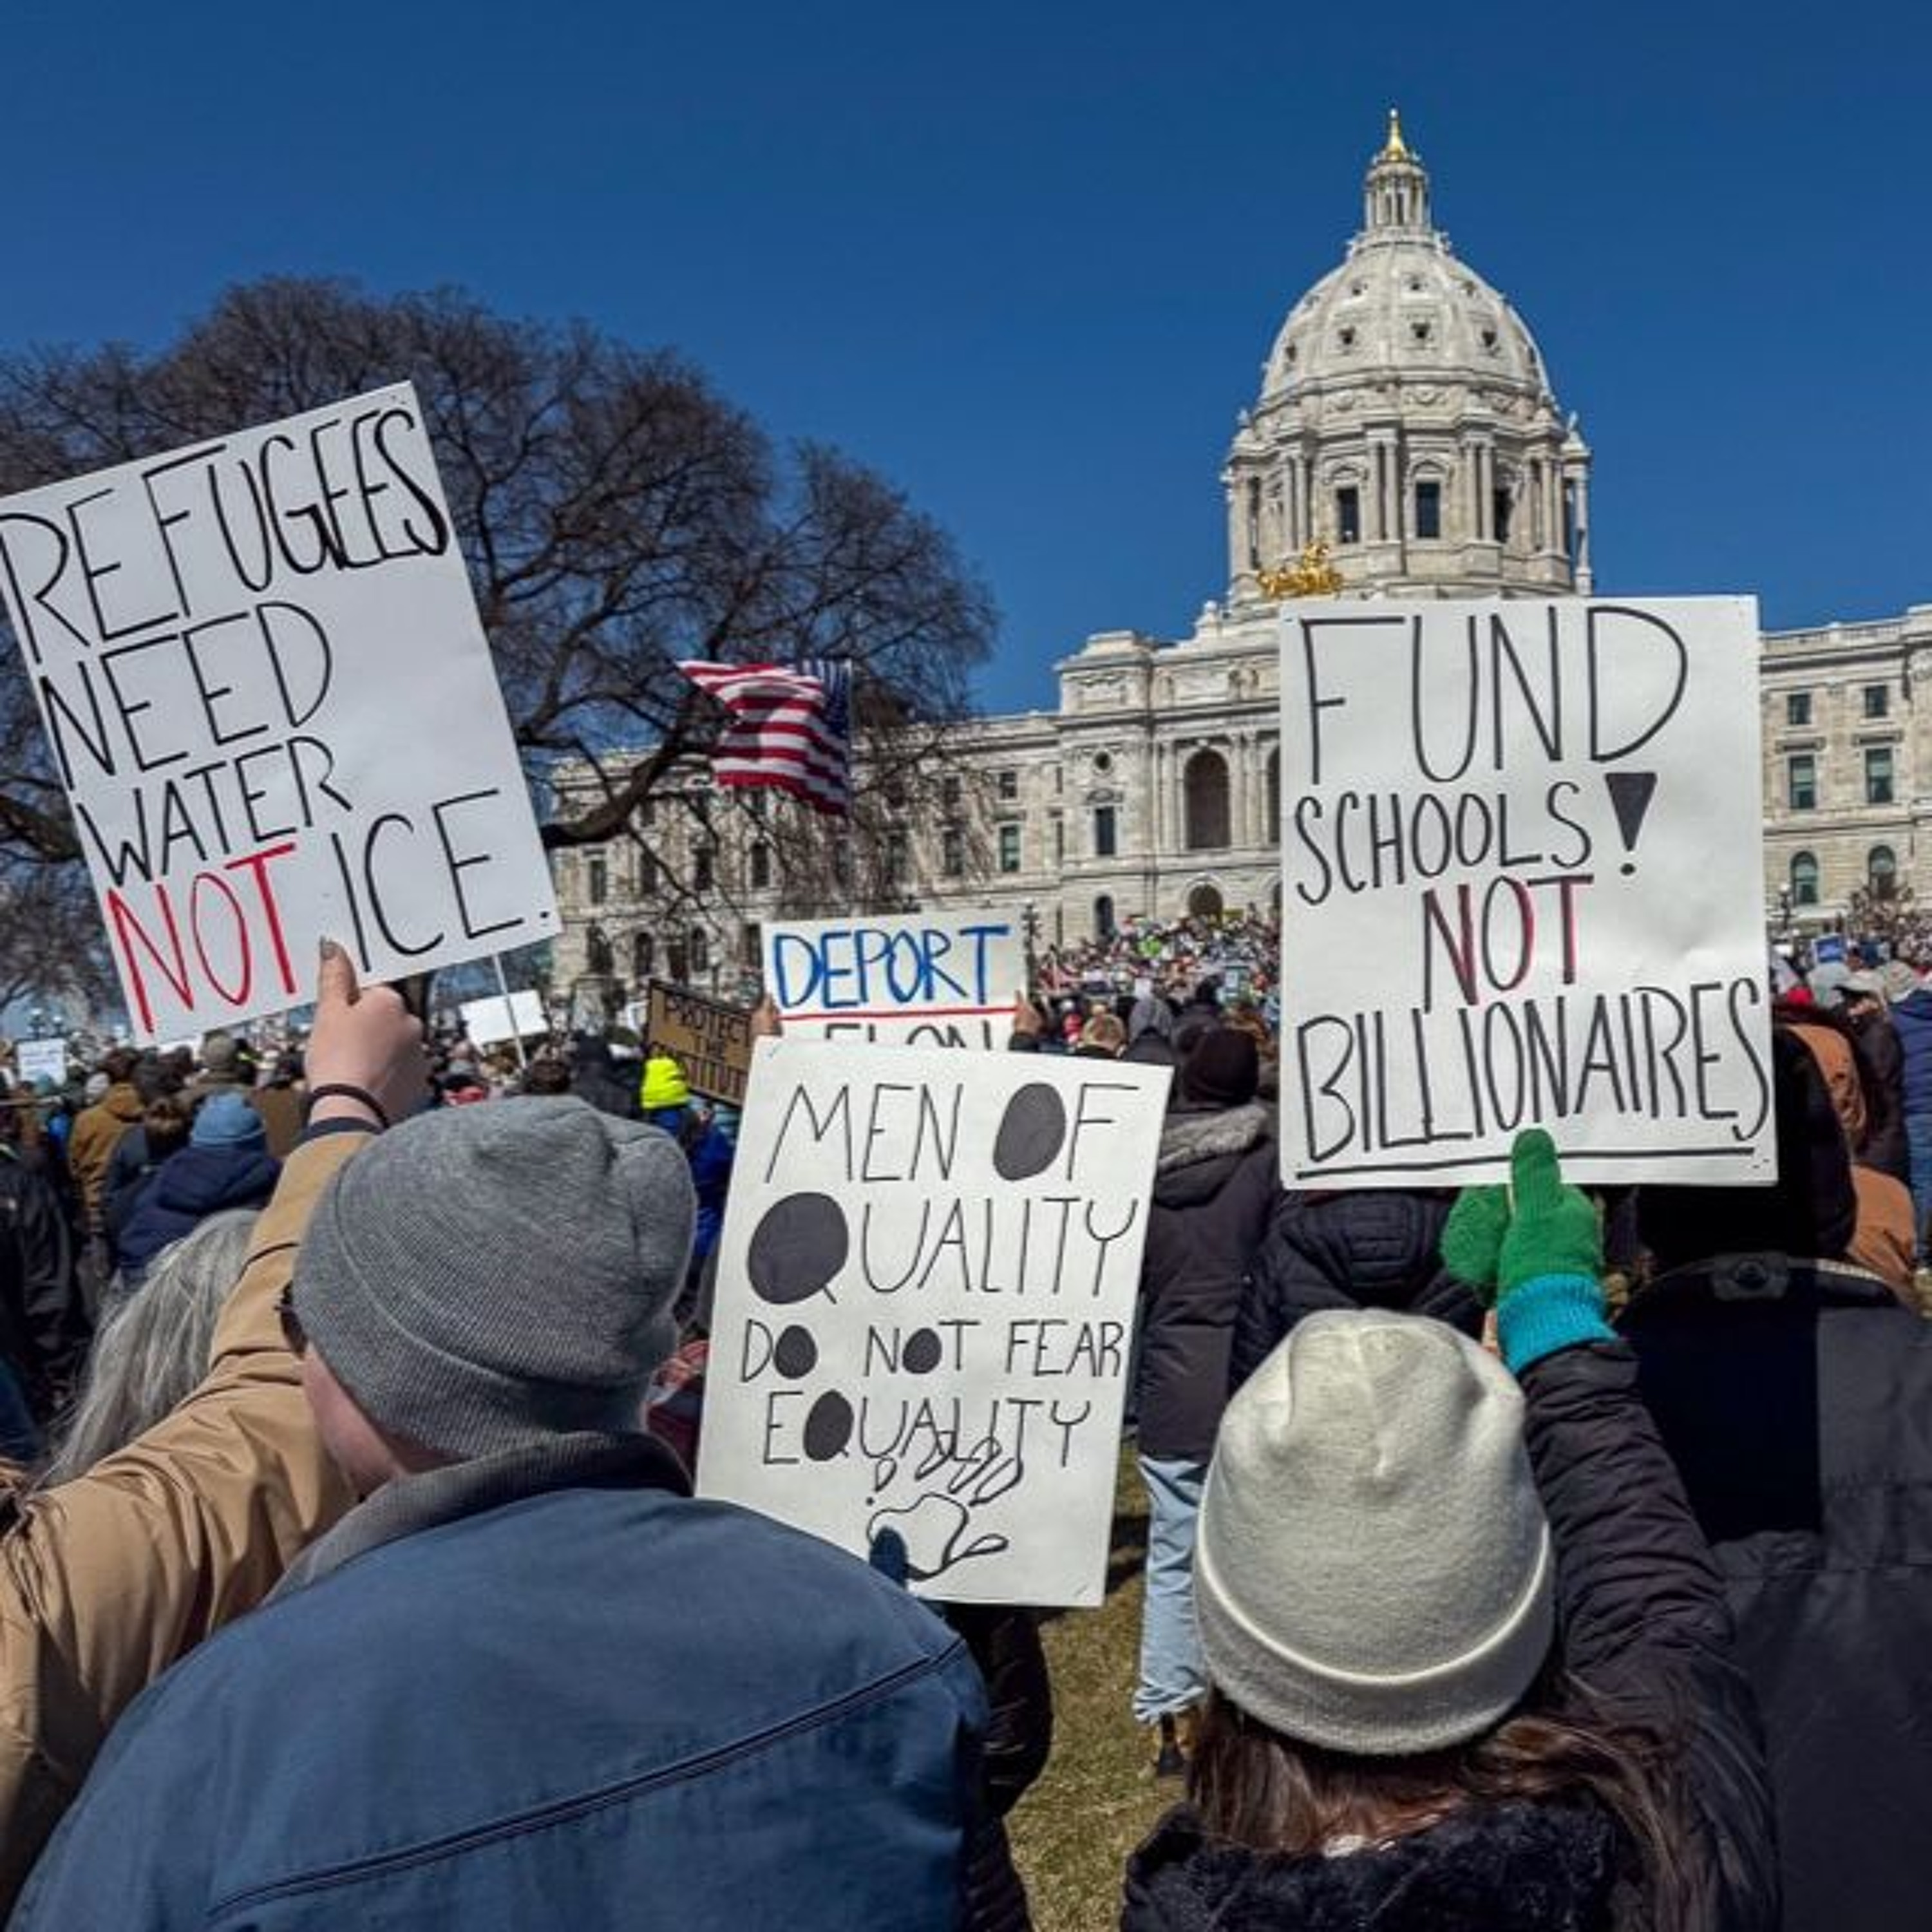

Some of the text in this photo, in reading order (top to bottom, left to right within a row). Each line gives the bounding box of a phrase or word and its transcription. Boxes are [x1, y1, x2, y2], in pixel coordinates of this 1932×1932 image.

[0, 408, 448, 664] REFUGEES
[40, 602, 332, 791] NEED
[1300, 606, 1688, 785] FUND
[76, 735, 352, 887] WATER
[106, 789, 550, 1033] NOT ICE.
[773, 924, 1010, 1009] DEPORT
[1423, 874, 1594, 1013] NOT
[764, 1081, 1139, 1184] MEN OF
[1296, 978, 1770, 1163] BILLIONAIRES
[746, 1191, 1139, 1306] QUALITY
[741, 1319, 1126, 1383] DO NOT FEAR
[763, 1389, 1091, 1467] EQUALITY
